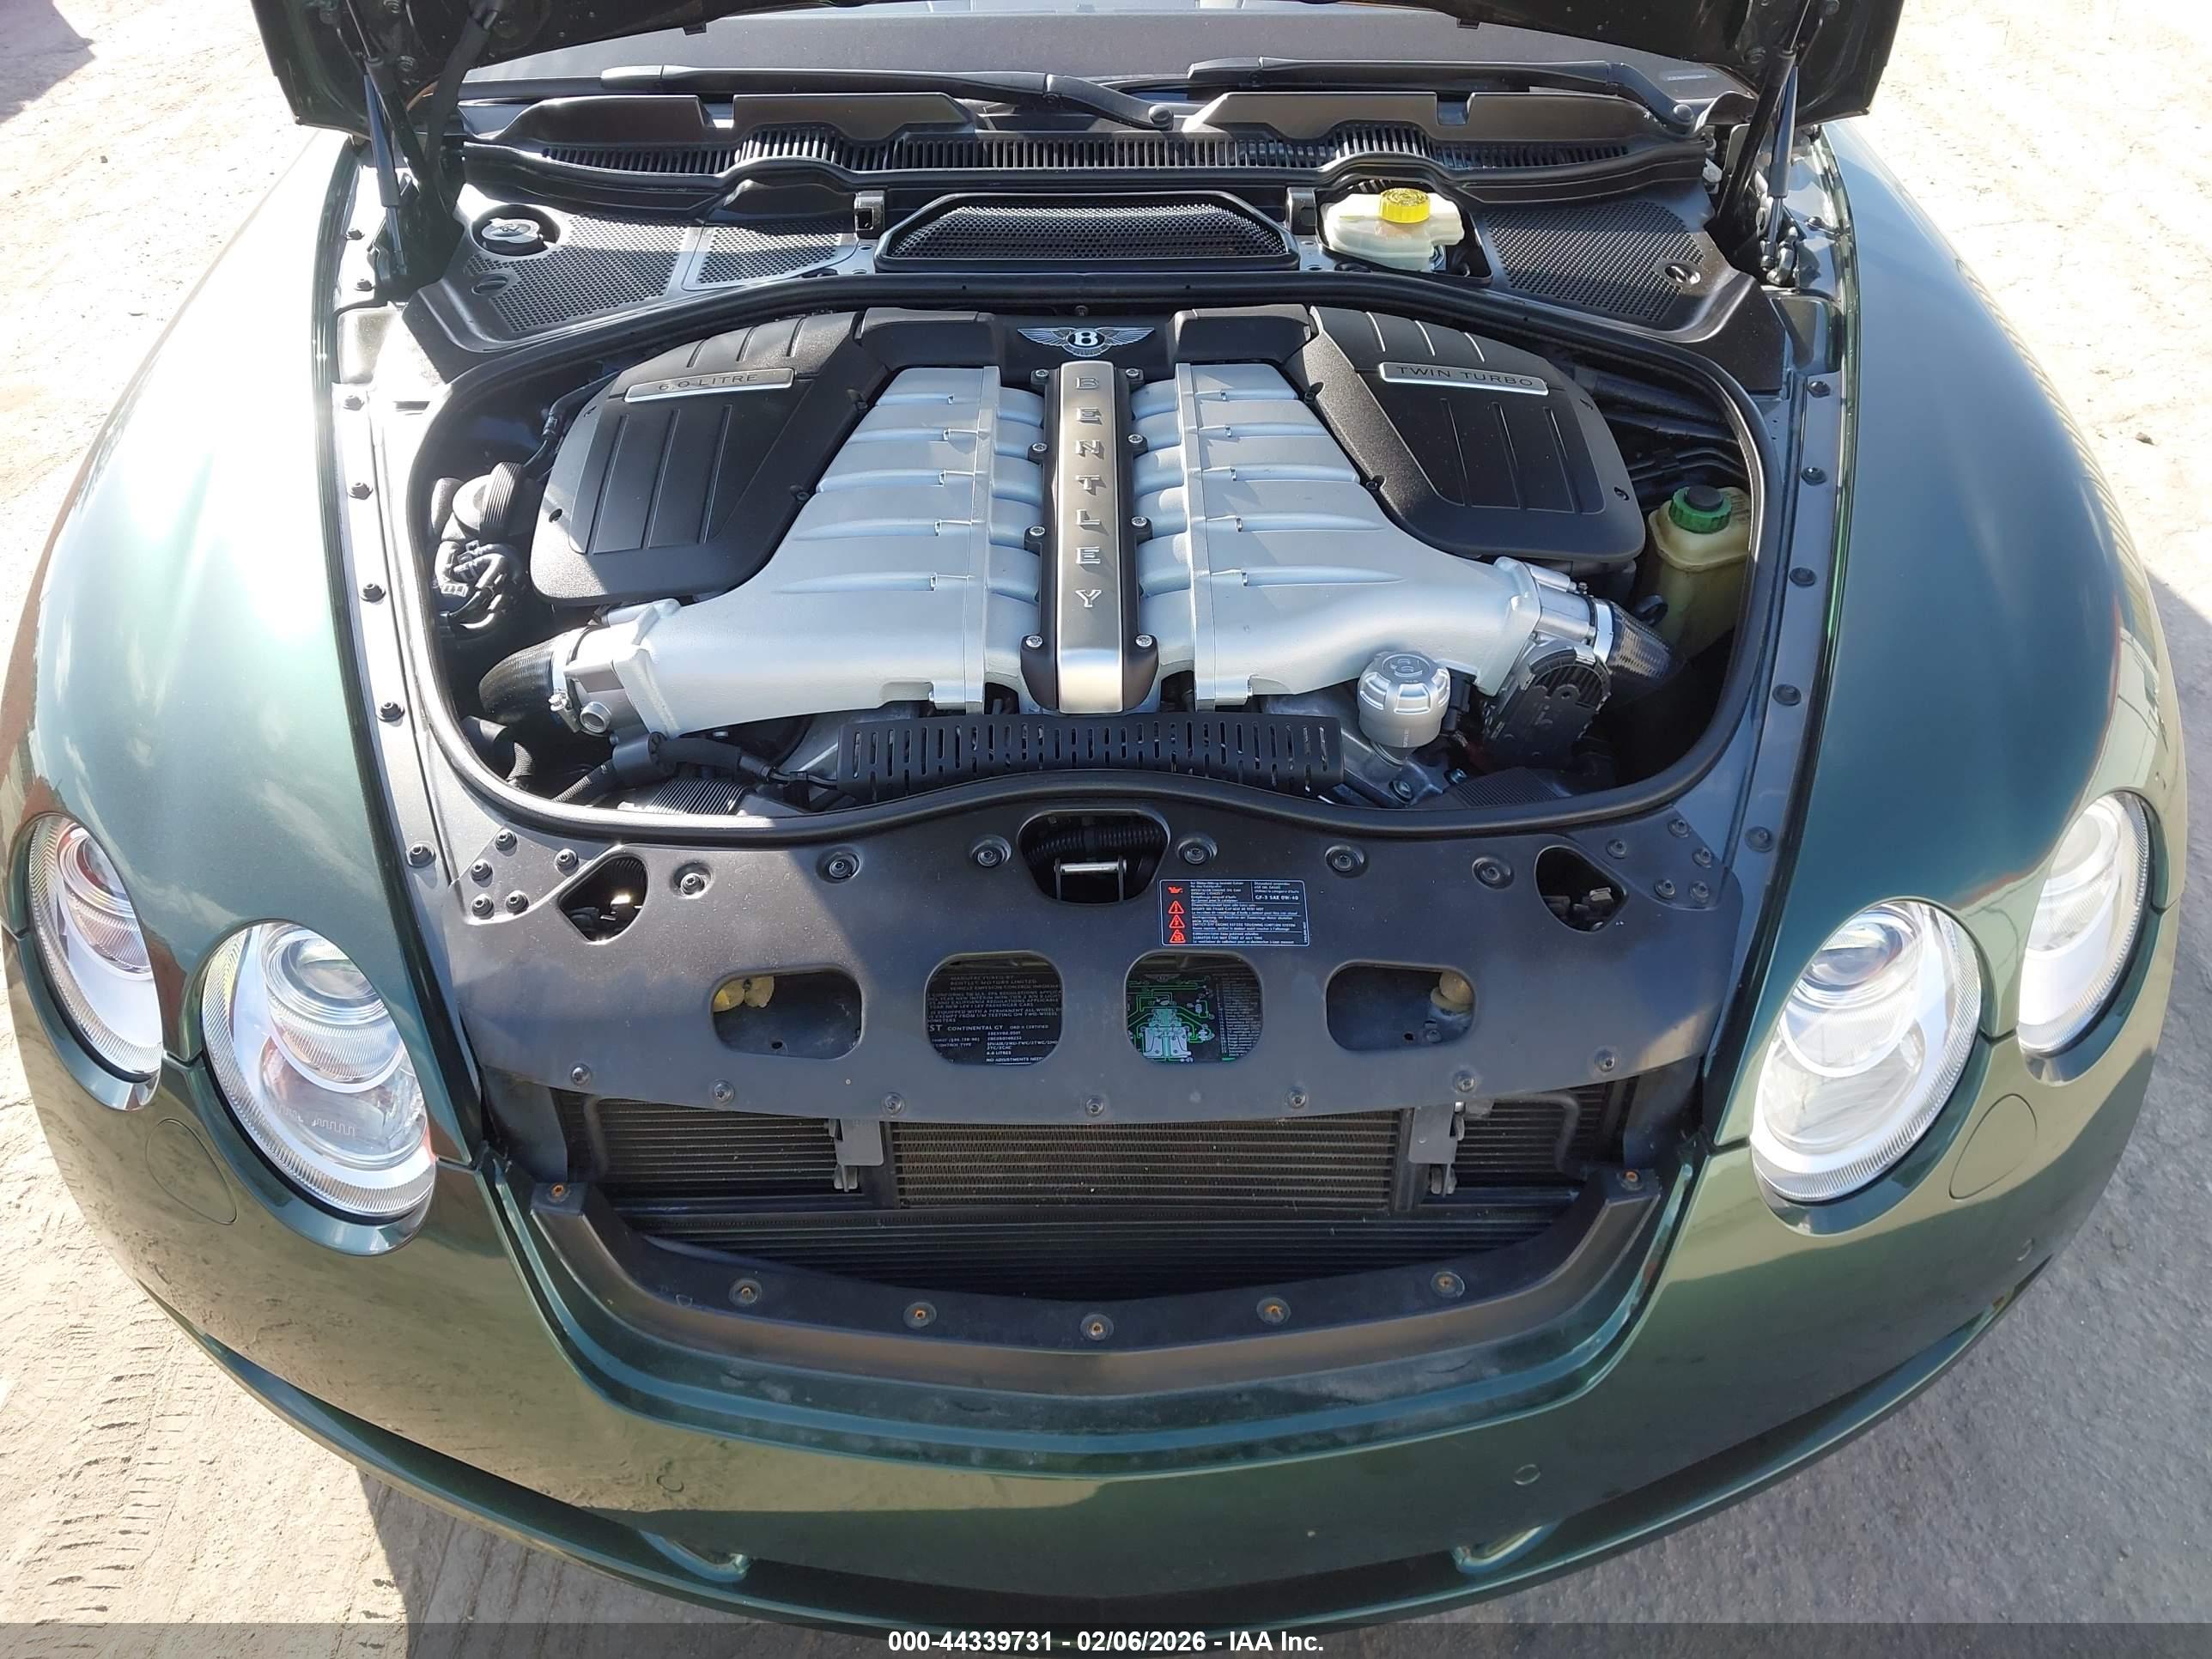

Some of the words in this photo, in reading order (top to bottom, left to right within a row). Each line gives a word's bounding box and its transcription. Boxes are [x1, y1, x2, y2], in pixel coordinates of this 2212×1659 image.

[659, 380, 690, 391] 6.0
[699, 374, 758, 386] LITRE
[1396, 366, 1451, 378] TWIN
[1460, 372, 1533, 386] TURBO
[1075, 377, 1103, 608] BENTLEY
